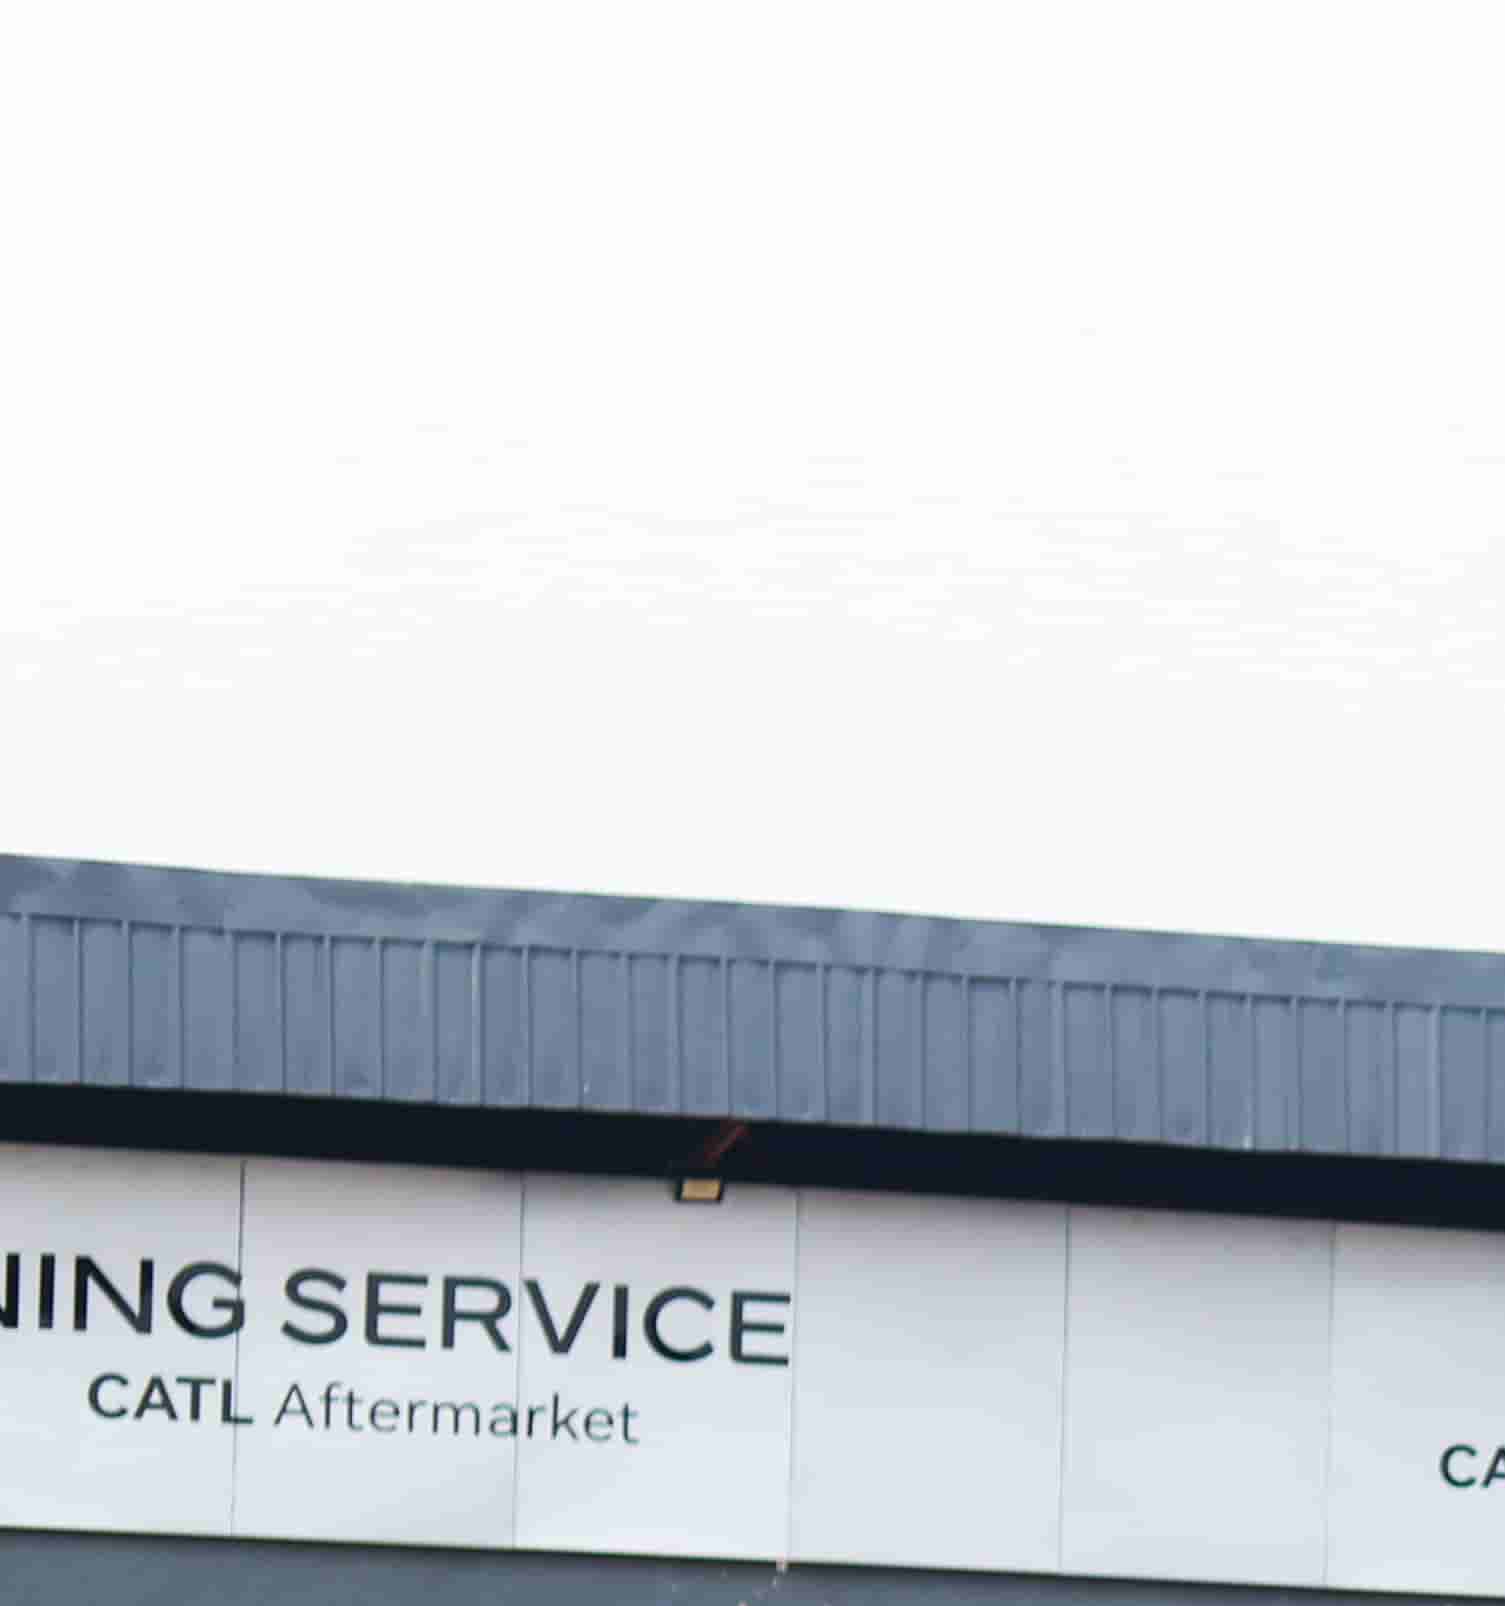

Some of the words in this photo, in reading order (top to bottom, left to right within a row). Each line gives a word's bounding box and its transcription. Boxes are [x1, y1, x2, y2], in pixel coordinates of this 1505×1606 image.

[282, 1268, 792, 1366] SERVICE
[87, 1373, 253, 1425] CATL
[274, 1382, 640, 1444] Aftermarket
